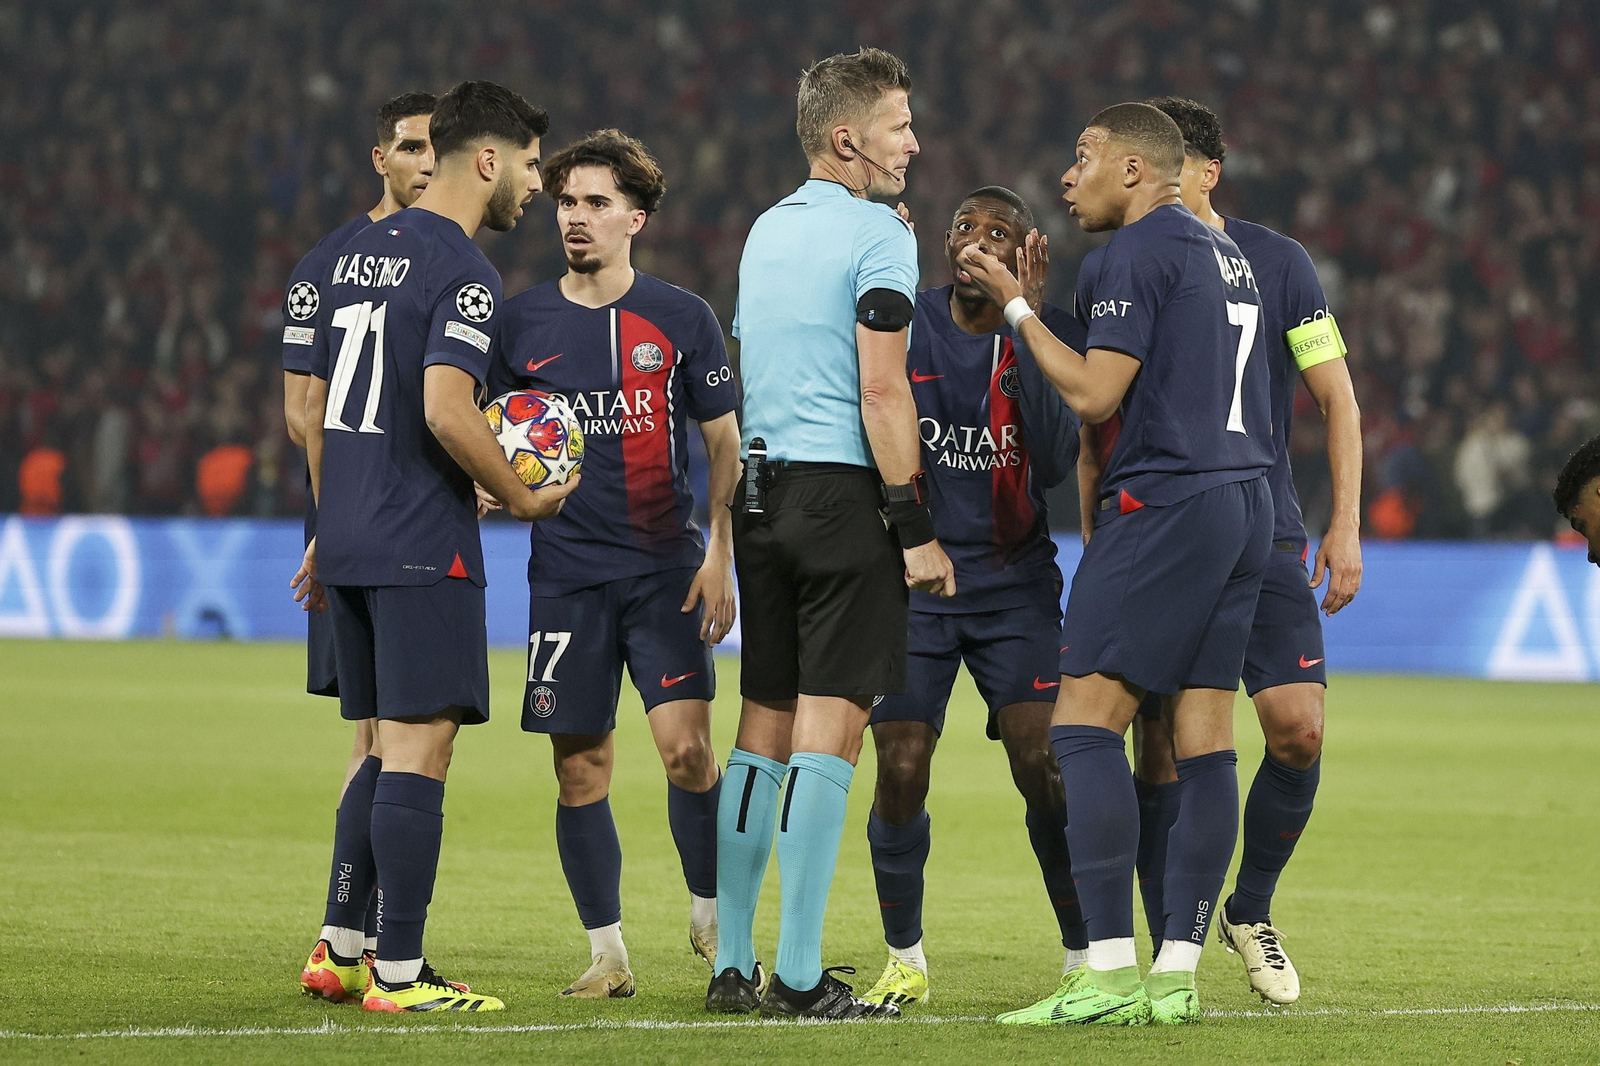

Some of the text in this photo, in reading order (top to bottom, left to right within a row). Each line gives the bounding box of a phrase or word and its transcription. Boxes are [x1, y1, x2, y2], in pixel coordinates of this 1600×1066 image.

[1294, 334, 1331, 355] RESPECT
[323, 300, 387, 434] 11
[706, 365, 734, 387] GO
[1225, 299, 1259, 438] 7
[550, 389, 654, 417] ATAR
[583, 415, 655, 435] IRWAYS
[918, 417, 1019, 453] QATAR
[937, 449, 1021, 472] AIRWAYS
[527, 630, 572, 682] 17
[337, 862, 353, 903] PARIS
[1191, 899, 1209, 941] PARIS
